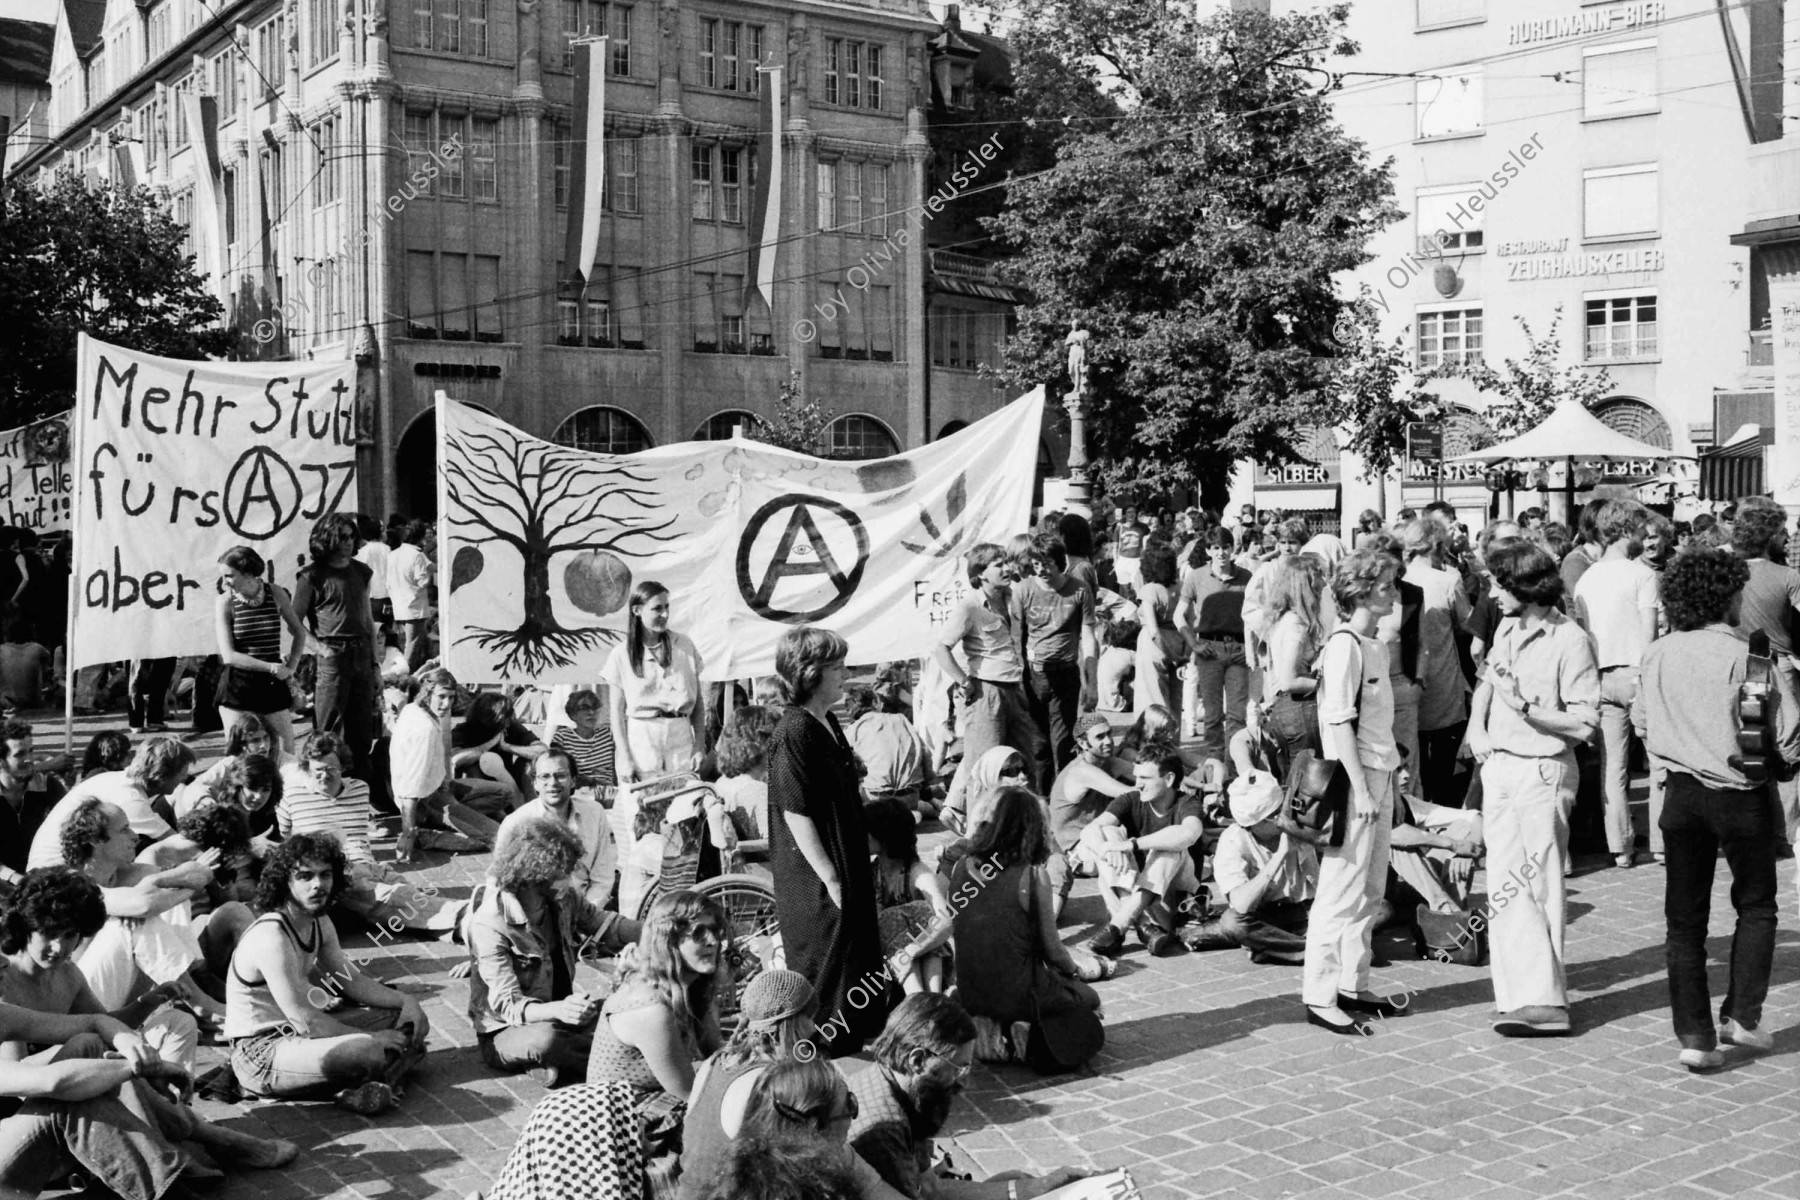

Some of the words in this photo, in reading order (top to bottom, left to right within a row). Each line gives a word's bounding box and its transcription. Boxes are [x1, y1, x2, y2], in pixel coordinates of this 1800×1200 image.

[1497, 238, 1569, 257] RESTAURANT
[1508, 250, 1665, 282] ZEUGHAUSKELLER
[93, 355, 237, 438] Mehr
[1267, 464, 1328, 483] SILBER
[86, 546, 200, 613] aber
